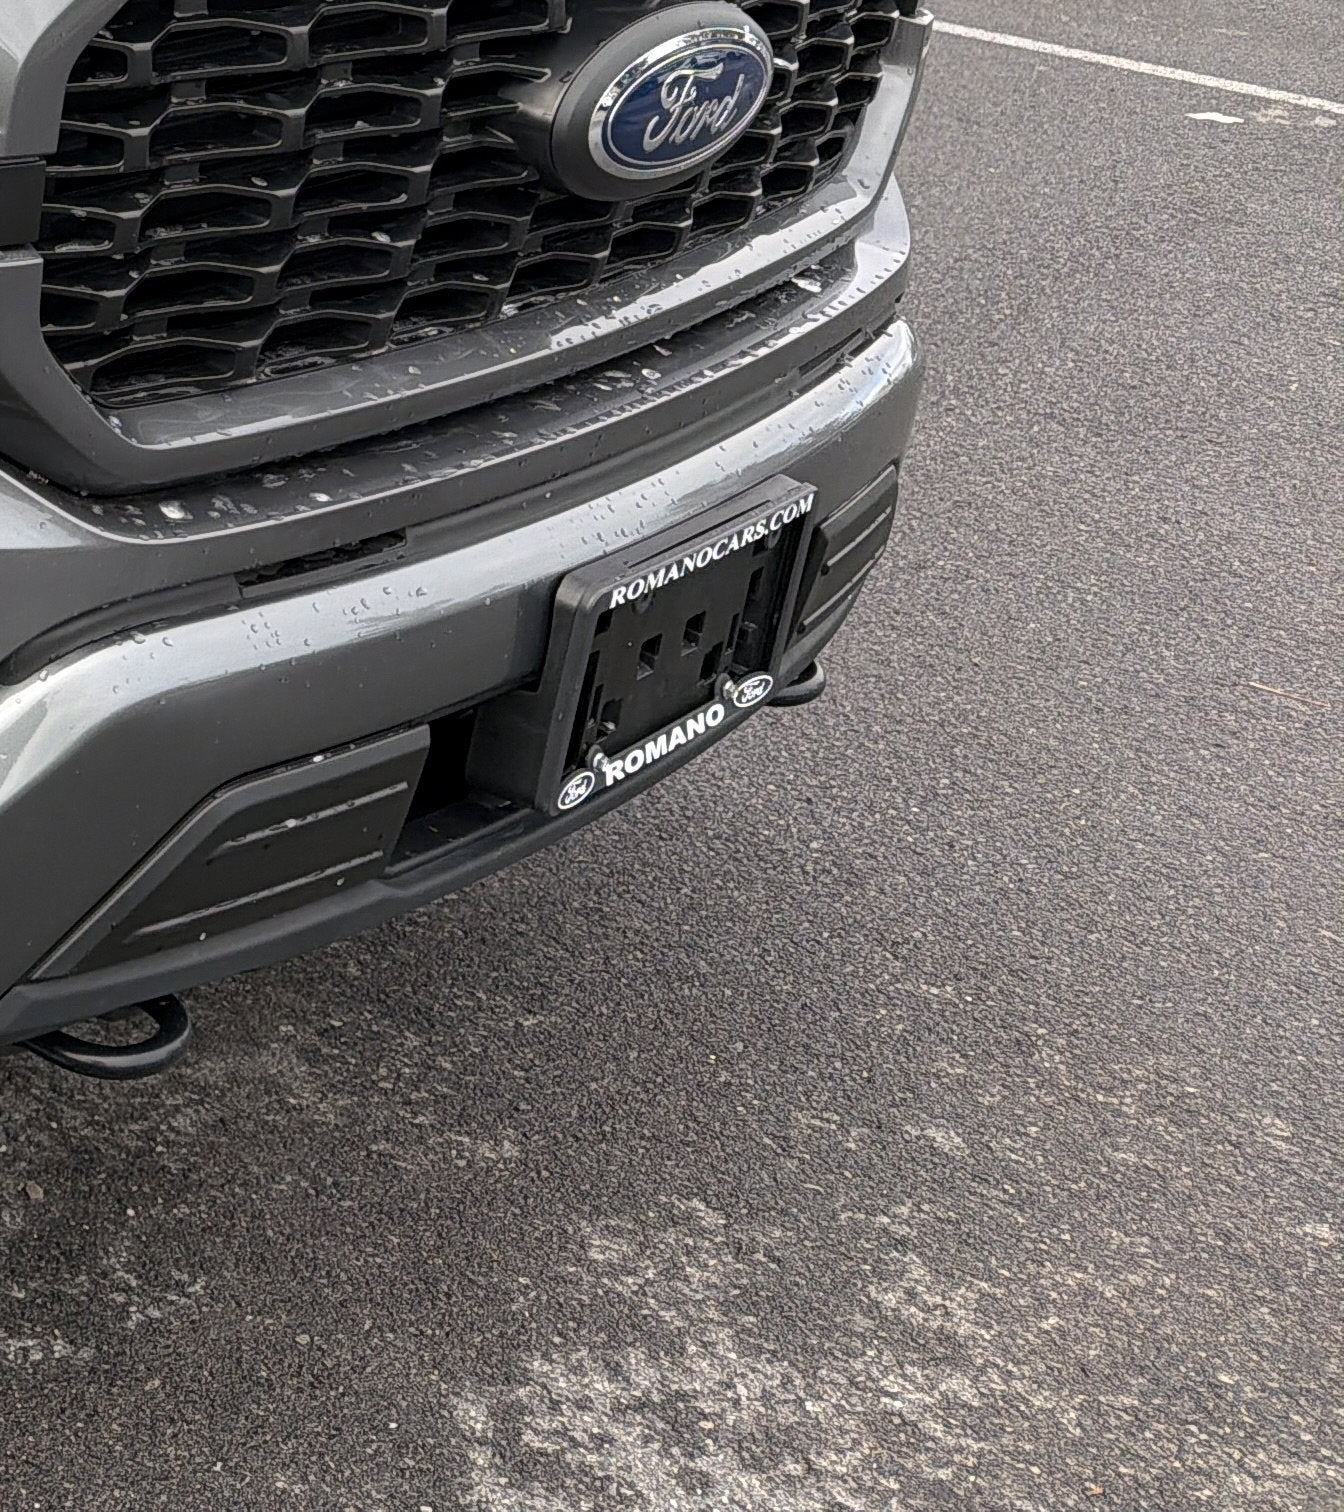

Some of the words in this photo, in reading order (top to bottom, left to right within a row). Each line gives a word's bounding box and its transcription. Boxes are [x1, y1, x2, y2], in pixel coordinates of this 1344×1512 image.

[643, 62, 745, 153] Ford
[609, 494, 815, 609] ROMANOCARS.COM
[605, 704, 725, 787] ROMANO
